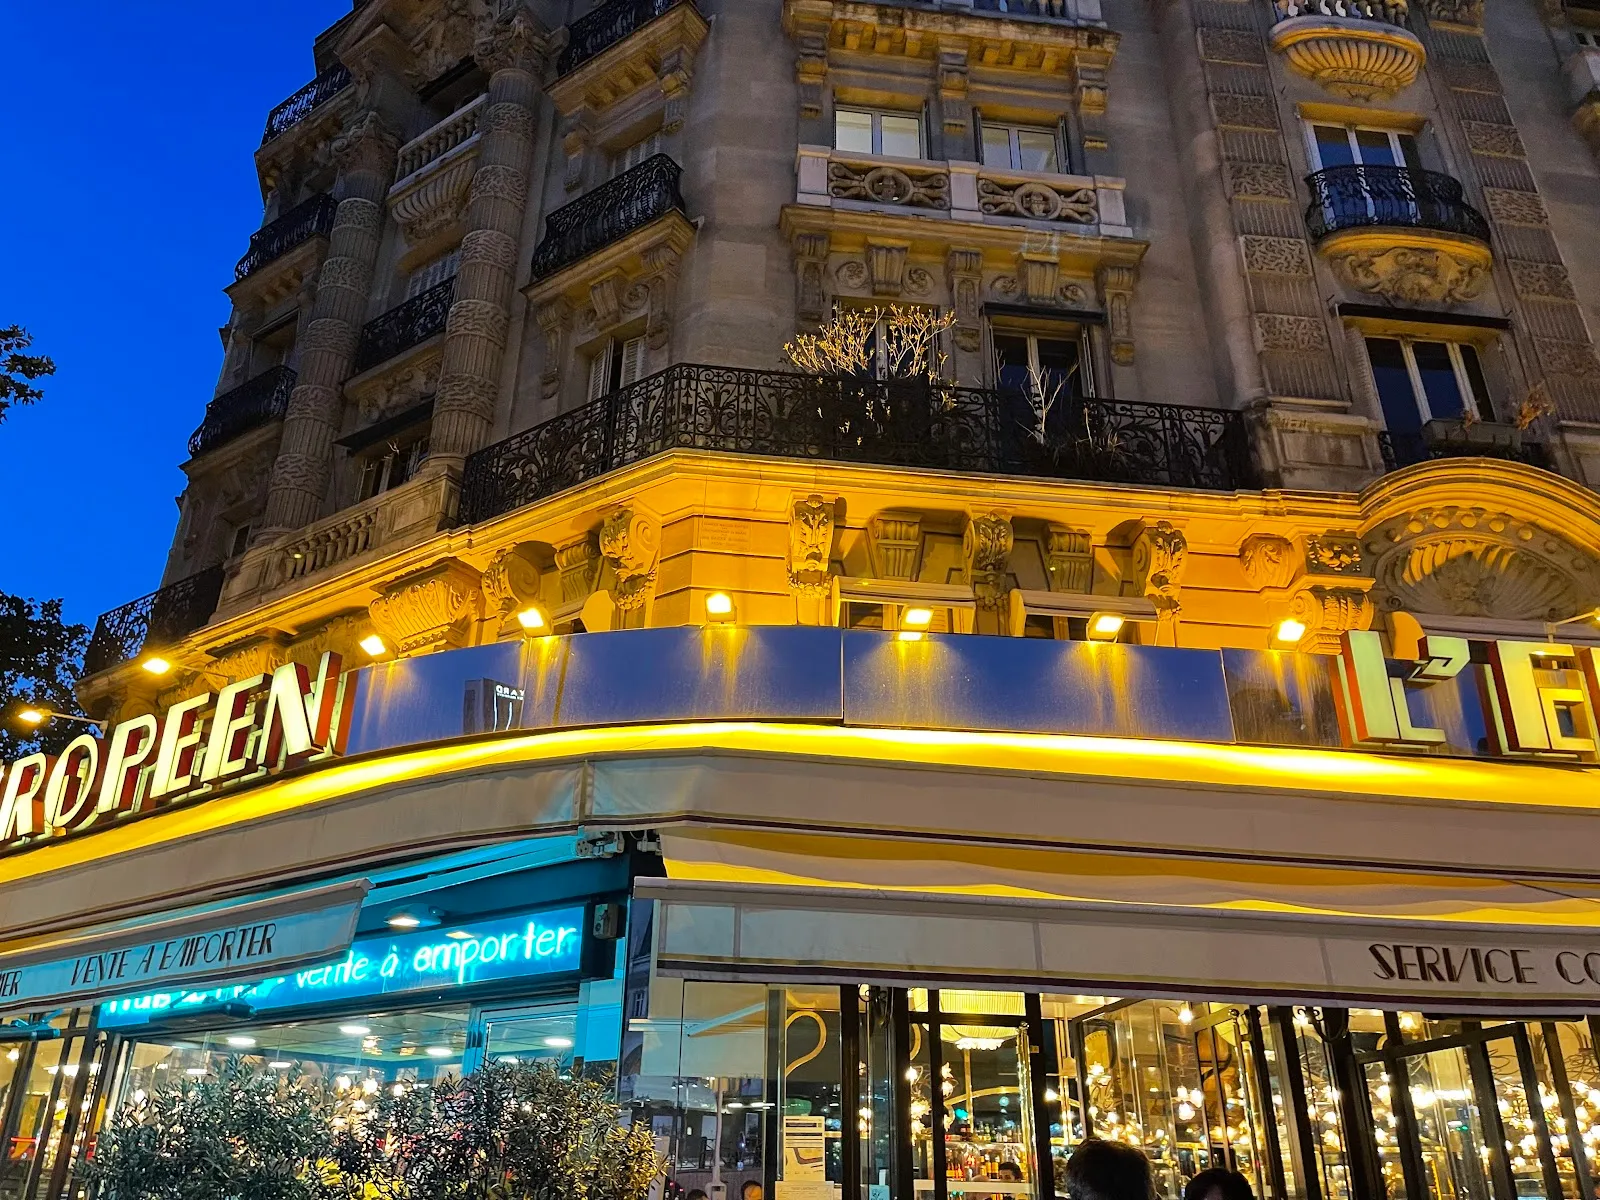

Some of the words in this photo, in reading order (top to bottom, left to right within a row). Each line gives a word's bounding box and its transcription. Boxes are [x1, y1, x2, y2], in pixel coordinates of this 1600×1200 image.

[1341, 630, 1600, 753] L'E
[0, 651, 342, 842] ROPEEN
[0, 970, 23, 998] ER
[70, 949, 132, 986] VENTE
[135, 944, 156, 976] A
[158, 922, 277, 971] EMPORTER
[380, 945, 399, 978] à
[413, 921, 577, 984] emporter
[1368, 943, 1538, 984] SERVICE
